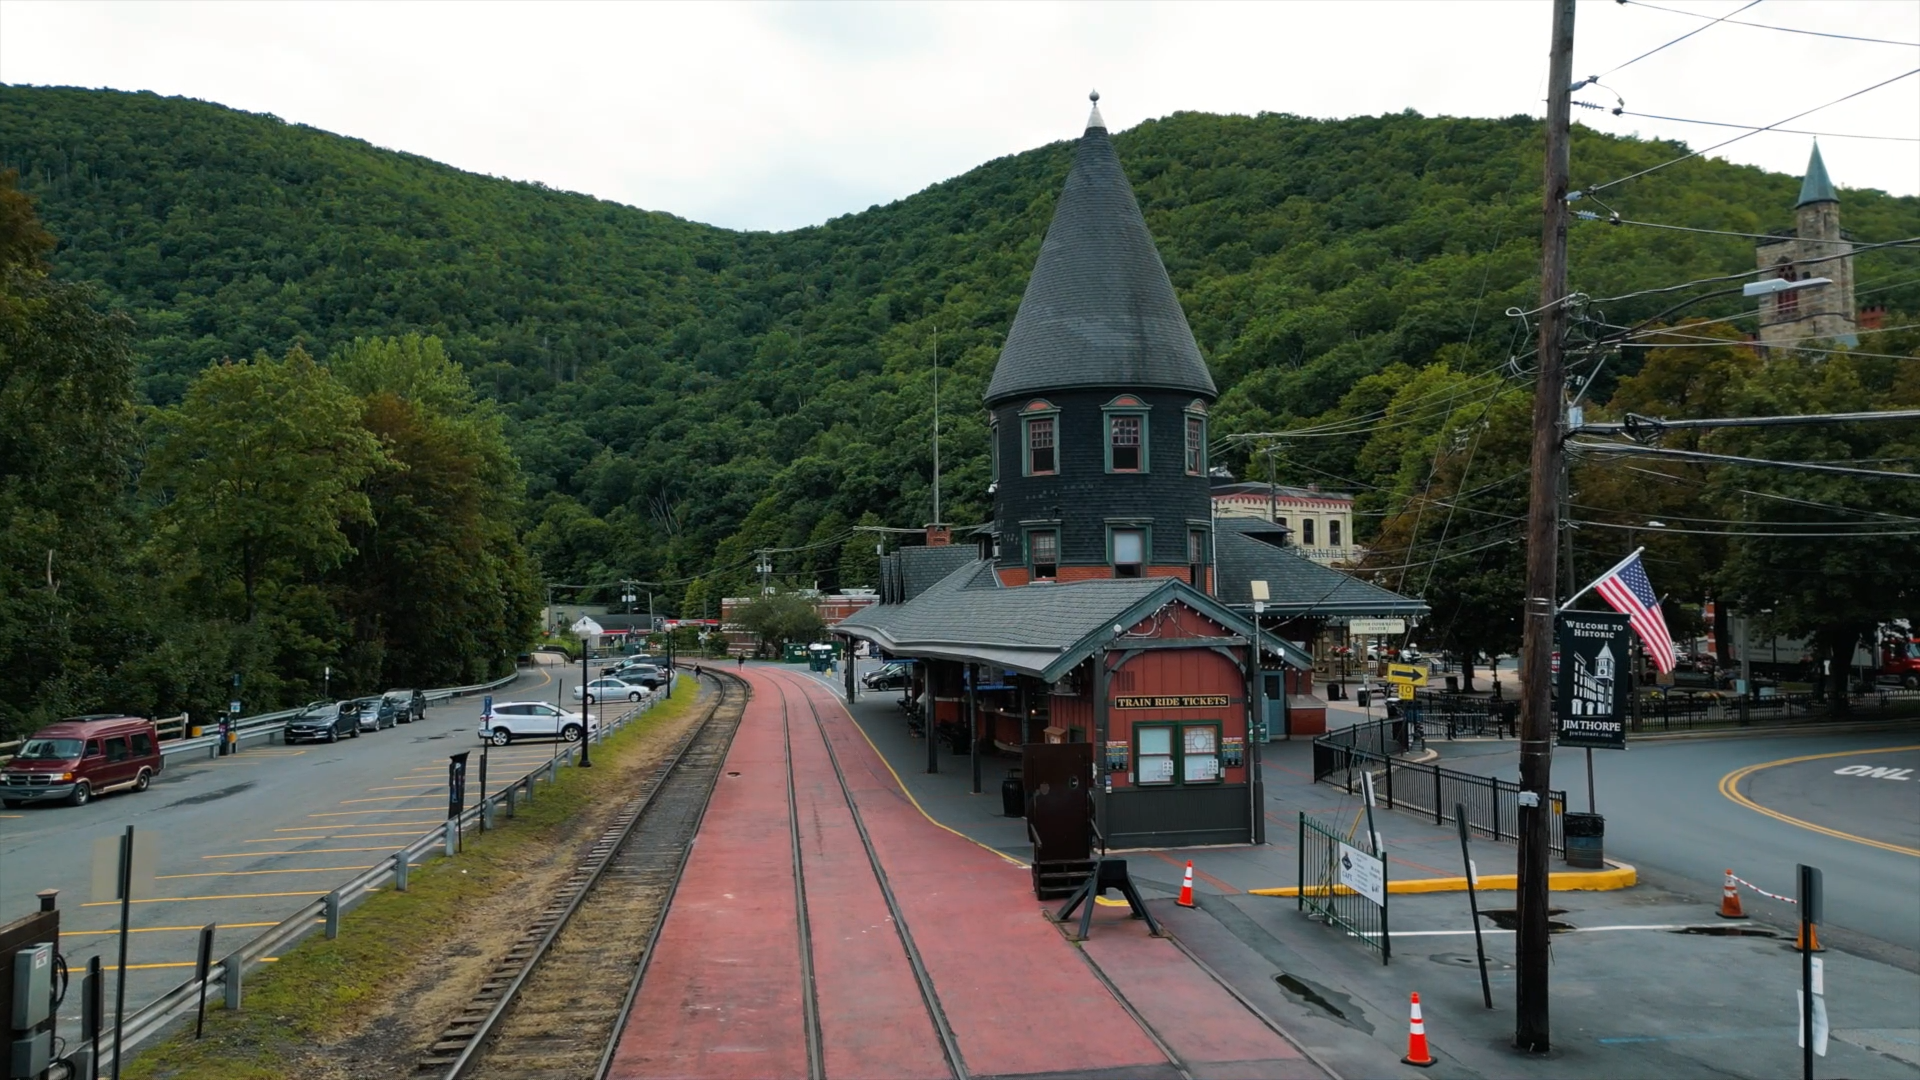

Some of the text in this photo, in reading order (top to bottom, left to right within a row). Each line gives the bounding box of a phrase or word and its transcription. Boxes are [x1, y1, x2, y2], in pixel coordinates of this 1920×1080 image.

[1297, 548, 1347, 559] RCANTILE
[1574, 629, 1614, 638] HISTORIC
[1401, 685, 1412, 693] 10
[1118, 697, 1226, 707] TRAIN RIDE TICKETS
[1562, 720, 1621, 732] JIM THORPE
[1833, 765, 1920, 782] ONL
